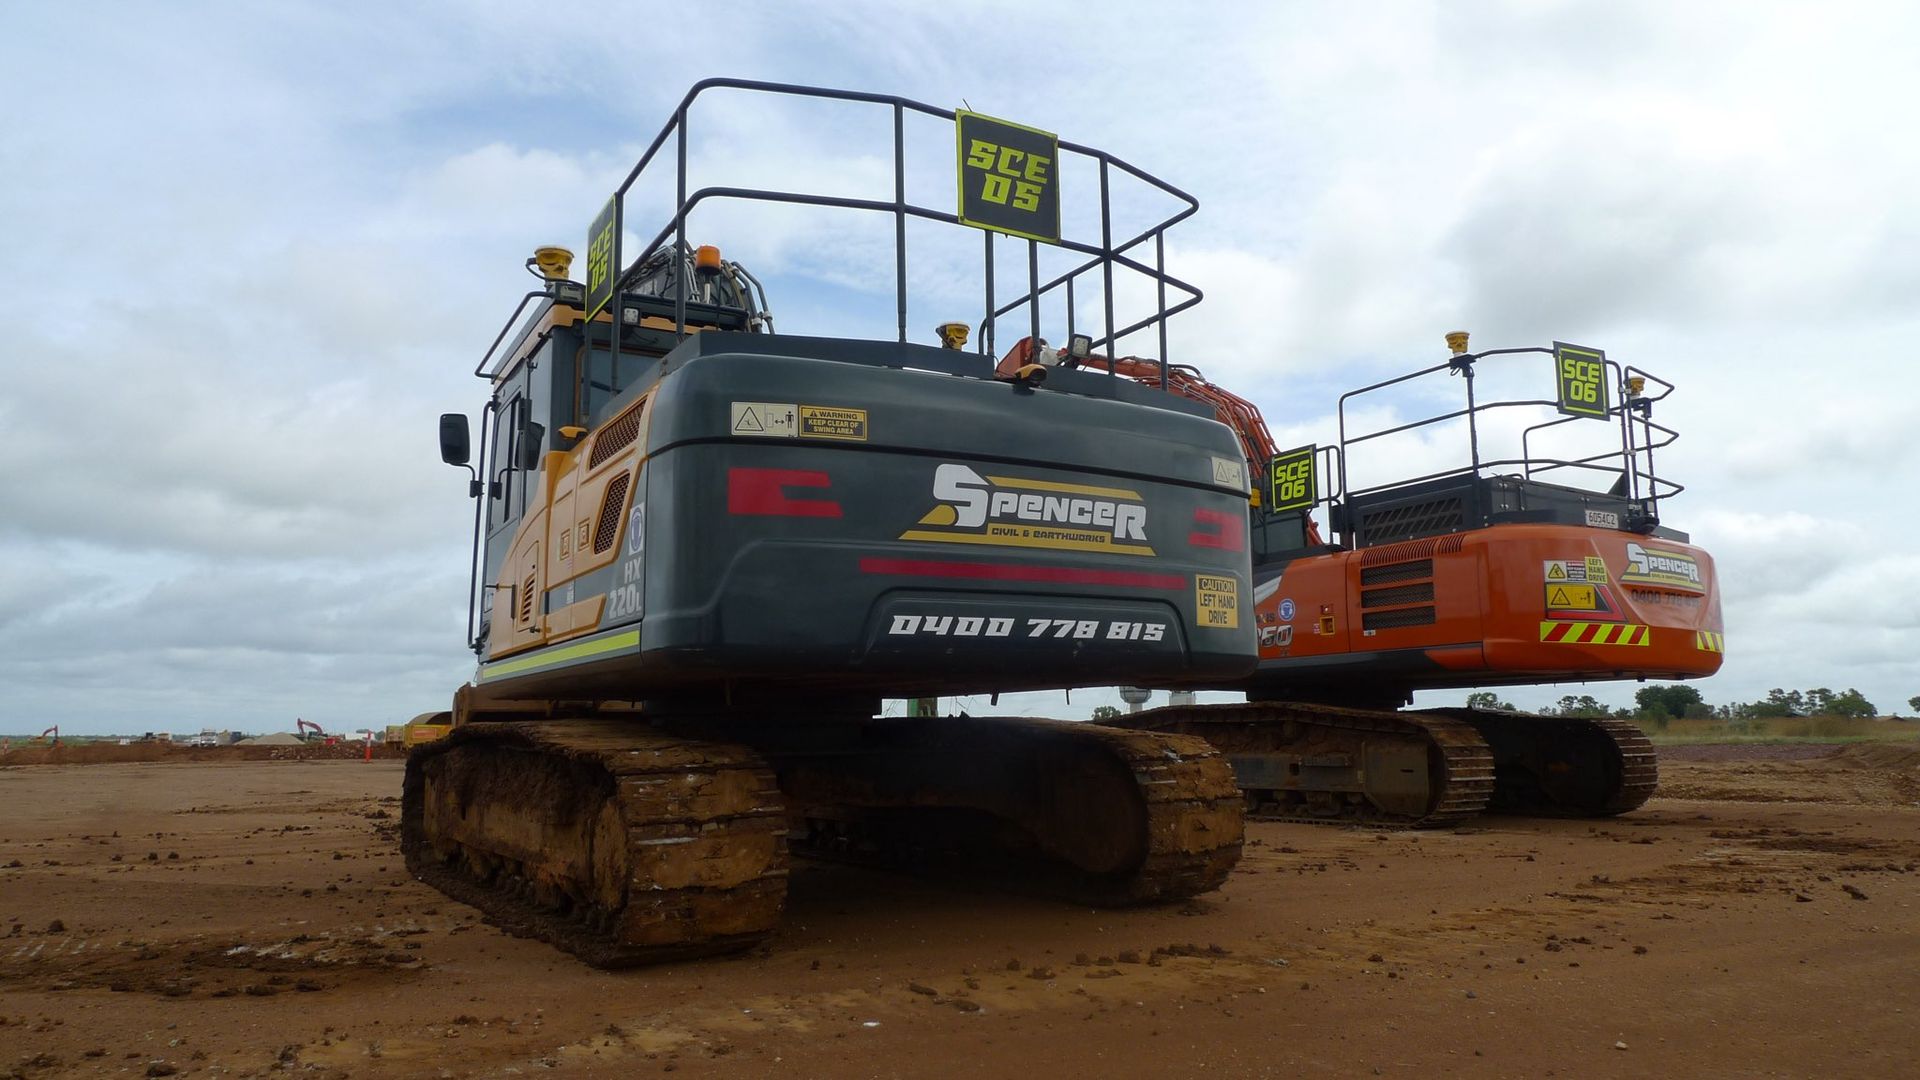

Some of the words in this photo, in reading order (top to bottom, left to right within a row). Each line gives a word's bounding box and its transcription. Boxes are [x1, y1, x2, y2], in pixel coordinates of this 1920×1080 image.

[966, 139, 1051, 184] SCE
[981, 173, 1042, 212] 05
[1564, 358, 1600, 383] SCE
[1570, 380, 1597, 403] 06
[808, 418, 826, 426] KEEP
[827, 419, 848, 427] CLEAR
[819, 412, 858, 420] WARNING
[836, 427, 854, 435] AREA
[1275, 459, 1310, 484] SCE
[1281, 479, 1305, 501] 06
[933, 463, 1147, 541] SPENCER
[991, 527, 1019, 537] CIVIL
[1023, 529, 1030, 538] &
[1032, 530, 1106, 543] EARTHWORKS
[624, 557, 641, 584] HX
[1588, 558, 1602, 566] LEFT
[1588, 566, 1604, 574] HAND
[1627, 543, 1699, 582] SPENCER
[1201, 578, 1234, 593] CAUTION
[1588, 574, 1606, 582] DRIVE
[1200, 593, 1216, 607] LEFT
[1218, 594, 1234, 609] HAND
[1208, 610, 1228, 624] DRIVE
[889, 615, 1015, 637] 0400
[1027, 618, 1099, 640] 778
[1106, 621, 1166, 641] 815
